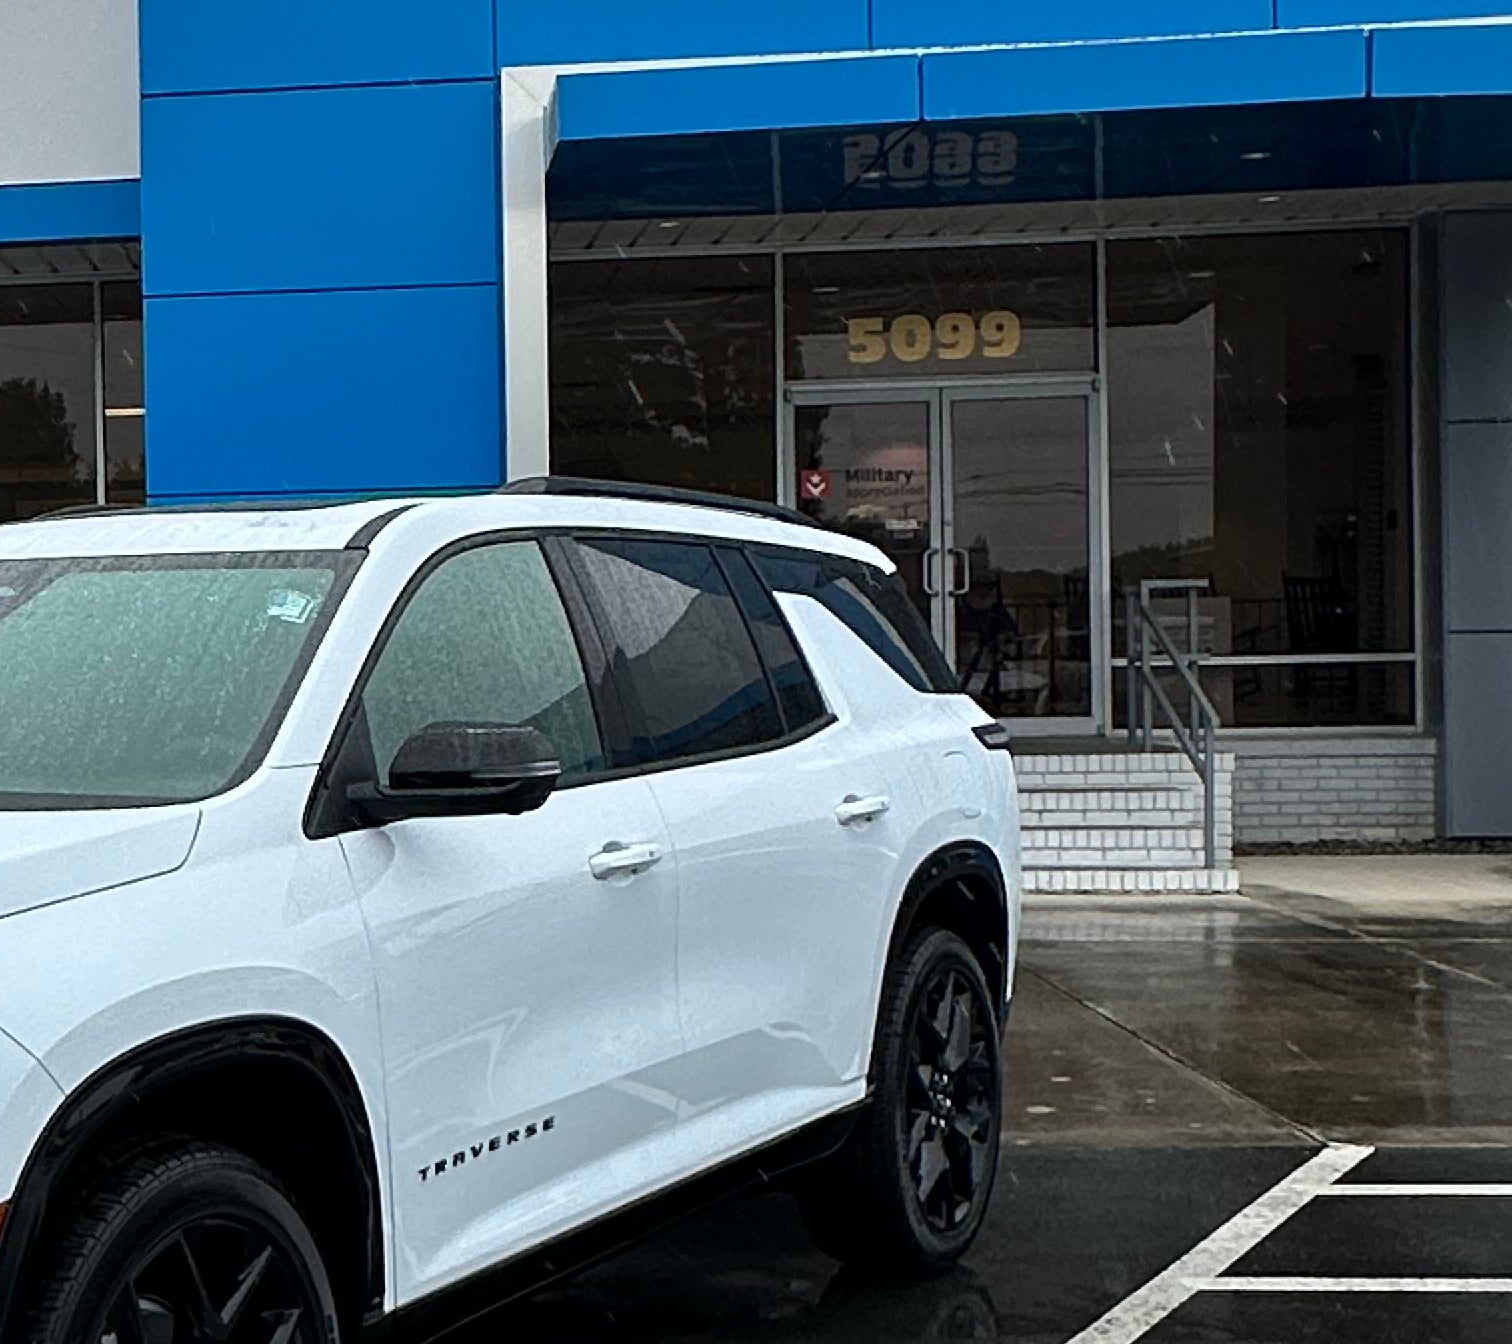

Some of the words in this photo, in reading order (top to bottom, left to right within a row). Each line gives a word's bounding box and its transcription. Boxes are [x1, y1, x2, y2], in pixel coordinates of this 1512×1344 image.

[847, 309, 1022, 364] 5099
[845, 467, 914, 486] Military
[418, 1115, 556, 1182] TRAVERSE
